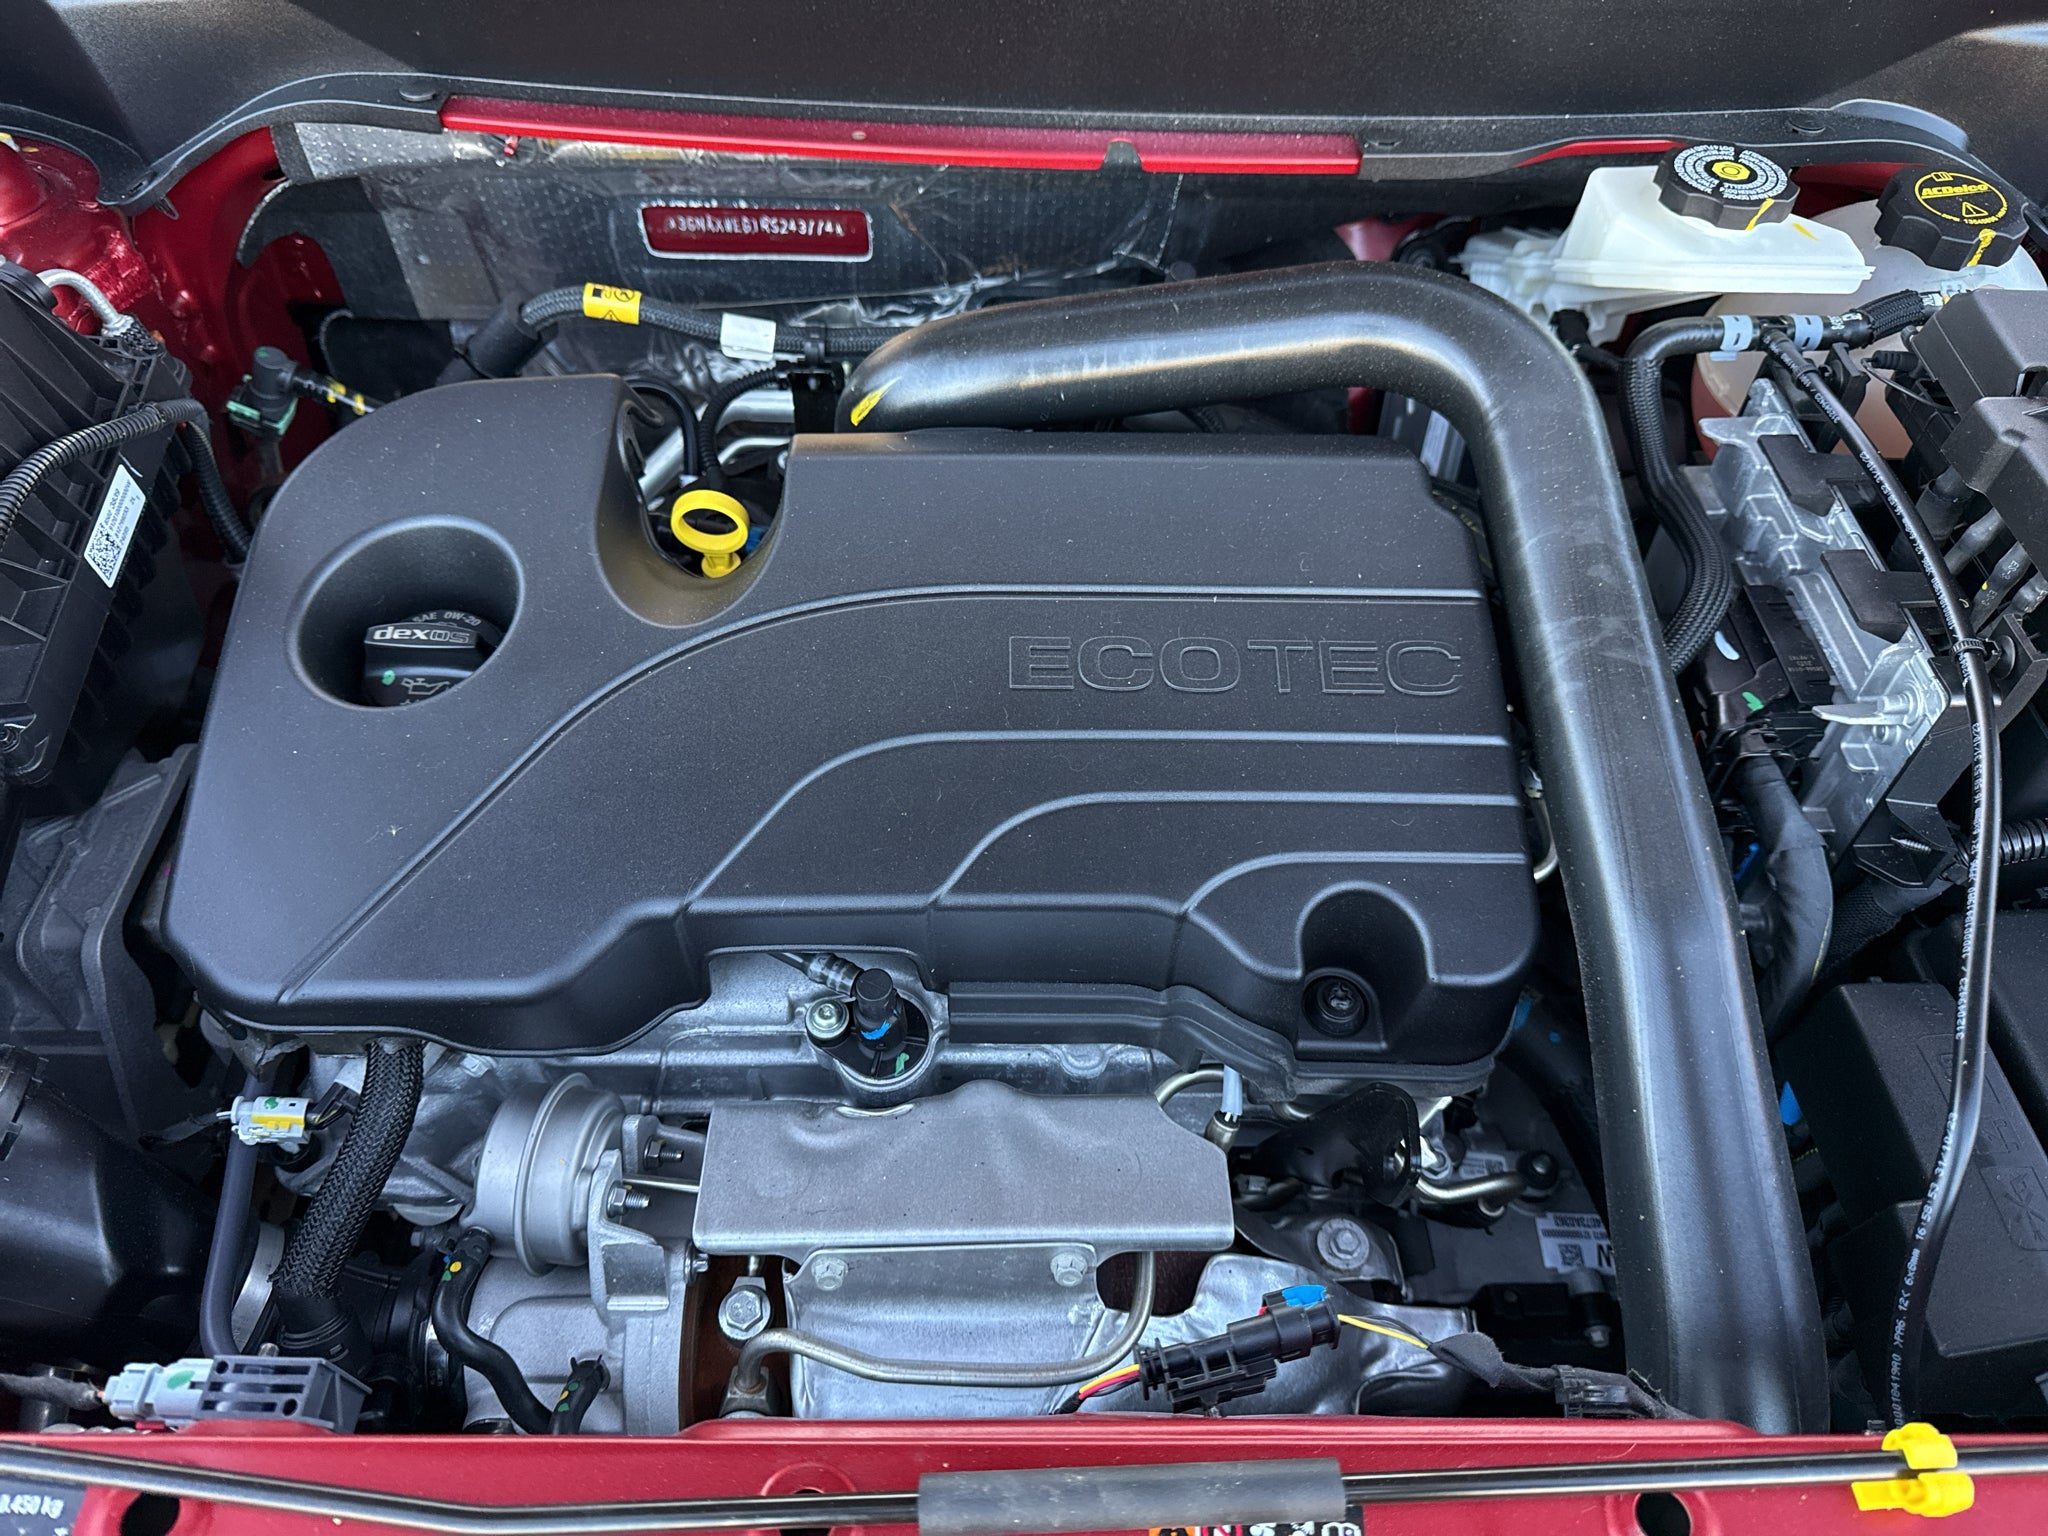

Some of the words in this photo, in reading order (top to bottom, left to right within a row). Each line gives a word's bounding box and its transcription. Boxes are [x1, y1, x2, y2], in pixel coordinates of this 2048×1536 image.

[1921, 184, 1988, 196] ACDelco
[443, 611, 481, 626] 0W-20
[373, 626, 470, 643] dexos
[1008, 635, 1463, 695] ECOTEC
[1972, 722, 1982, 760] 31/10/23
[1915, 1183, 1941, 1241] 16:58:53
[1934, 1112, 1959, 1177] 31/10/23
